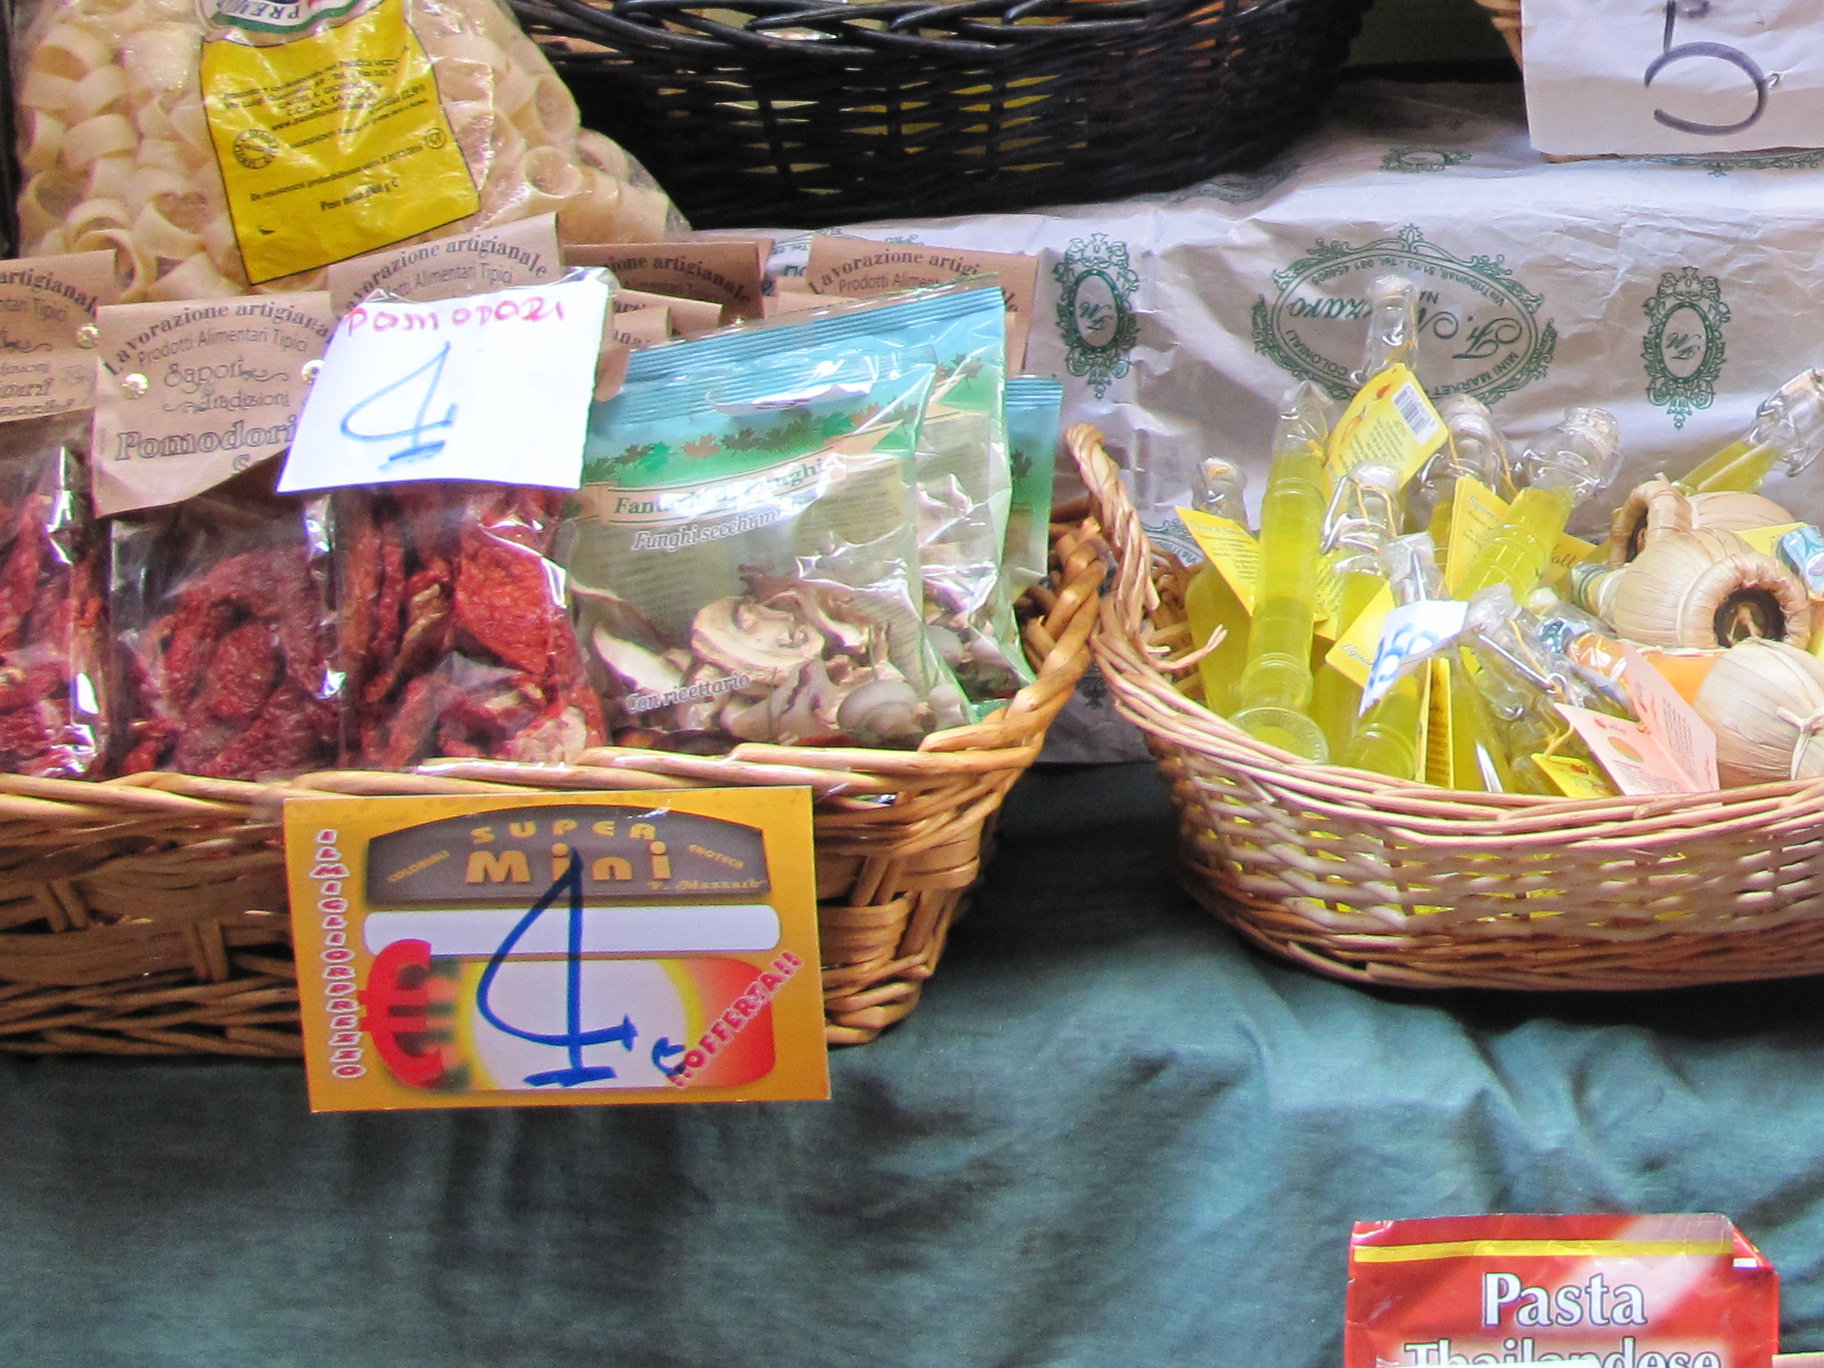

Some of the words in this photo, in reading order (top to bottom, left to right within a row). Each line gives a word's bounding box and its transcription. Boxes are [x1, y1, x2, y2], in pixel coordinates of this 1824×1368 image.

[445, 234, 549, 279] artigianale
[808, 249, 925, 297] Lavorazione
[103, 303, 229, 376] Lavorazione
[197, 327, 268, 349] Alimentari
[115, 414, 297, 462] Pomodori
[631, 524, 700, 552] Funghi
[625, 691, 660, 714] Con
[661, 672, 752, 707] ricettario
[472, 818, 657, 845] SUPER
[465, 840, 673, 885] Mini
[1482, 1271, 1648, 1328] Pasta
